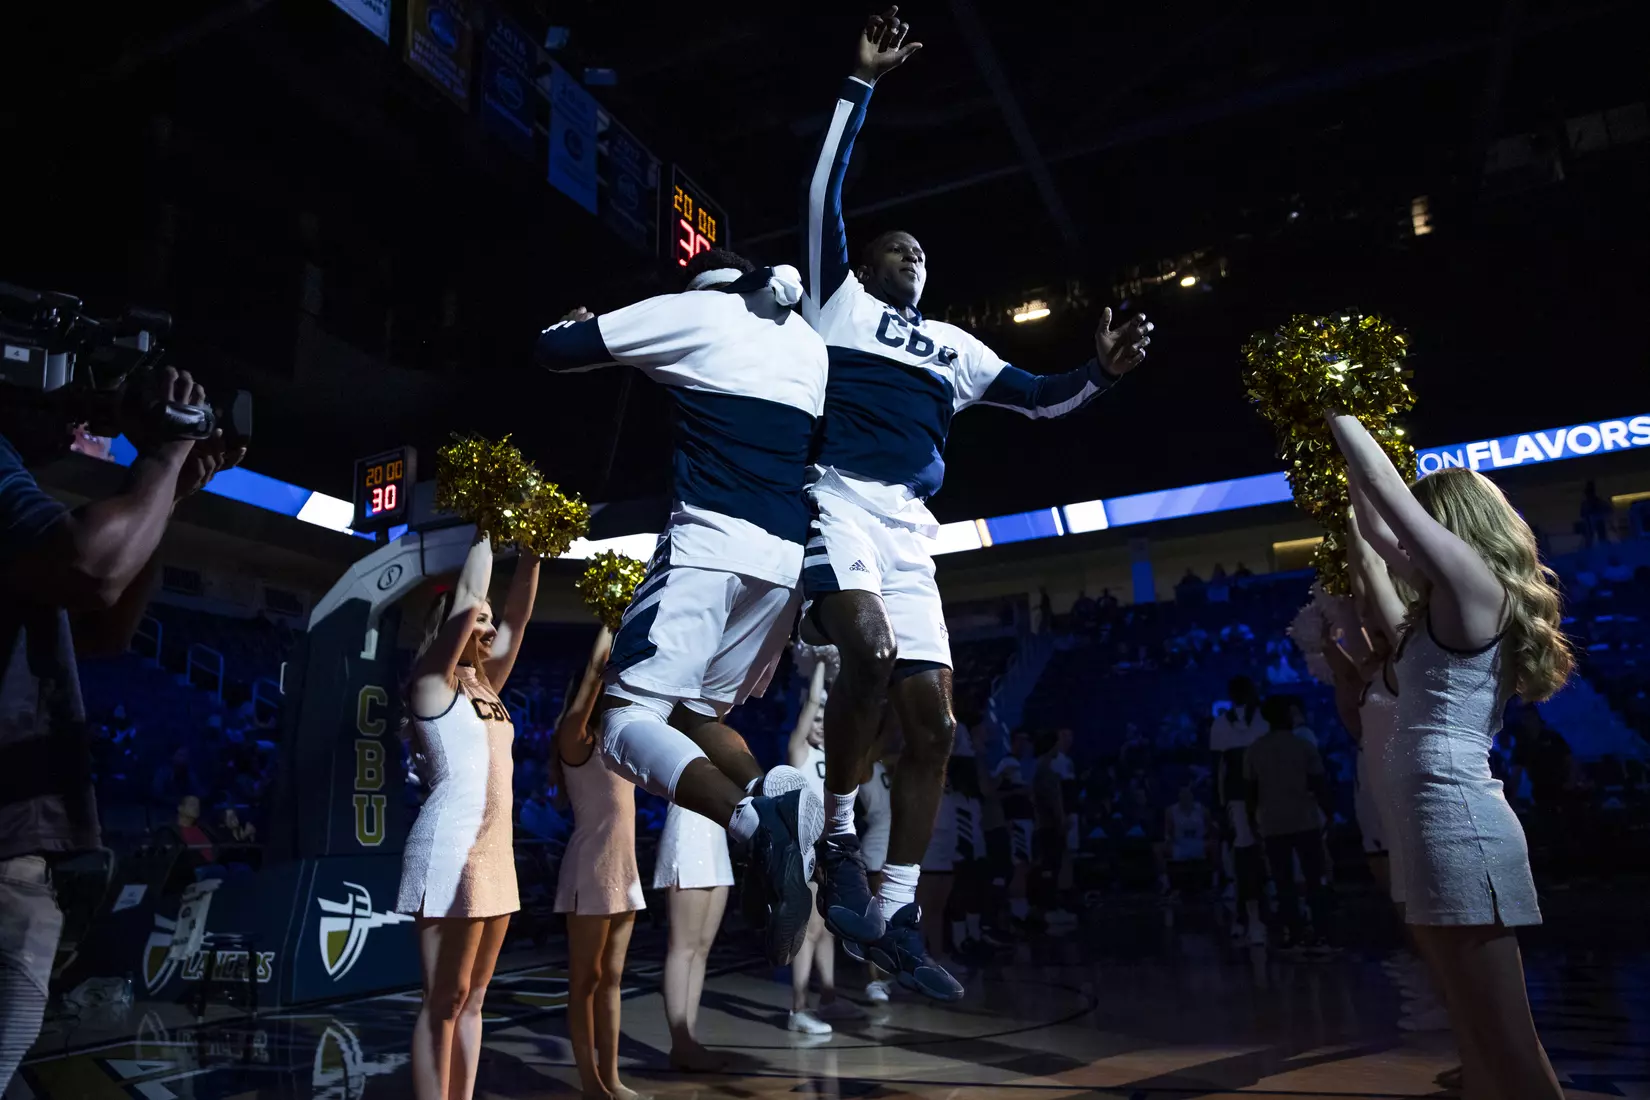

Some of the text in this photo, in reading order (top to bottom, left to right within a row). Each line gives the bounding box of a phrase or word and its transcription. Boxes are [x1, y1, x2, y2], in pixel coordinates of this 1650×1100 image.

[1416, 416, 1650, 476] ON FLAVORS
[372, 484, 397, 513] 30
[352, 684, 388, 847] CBU
